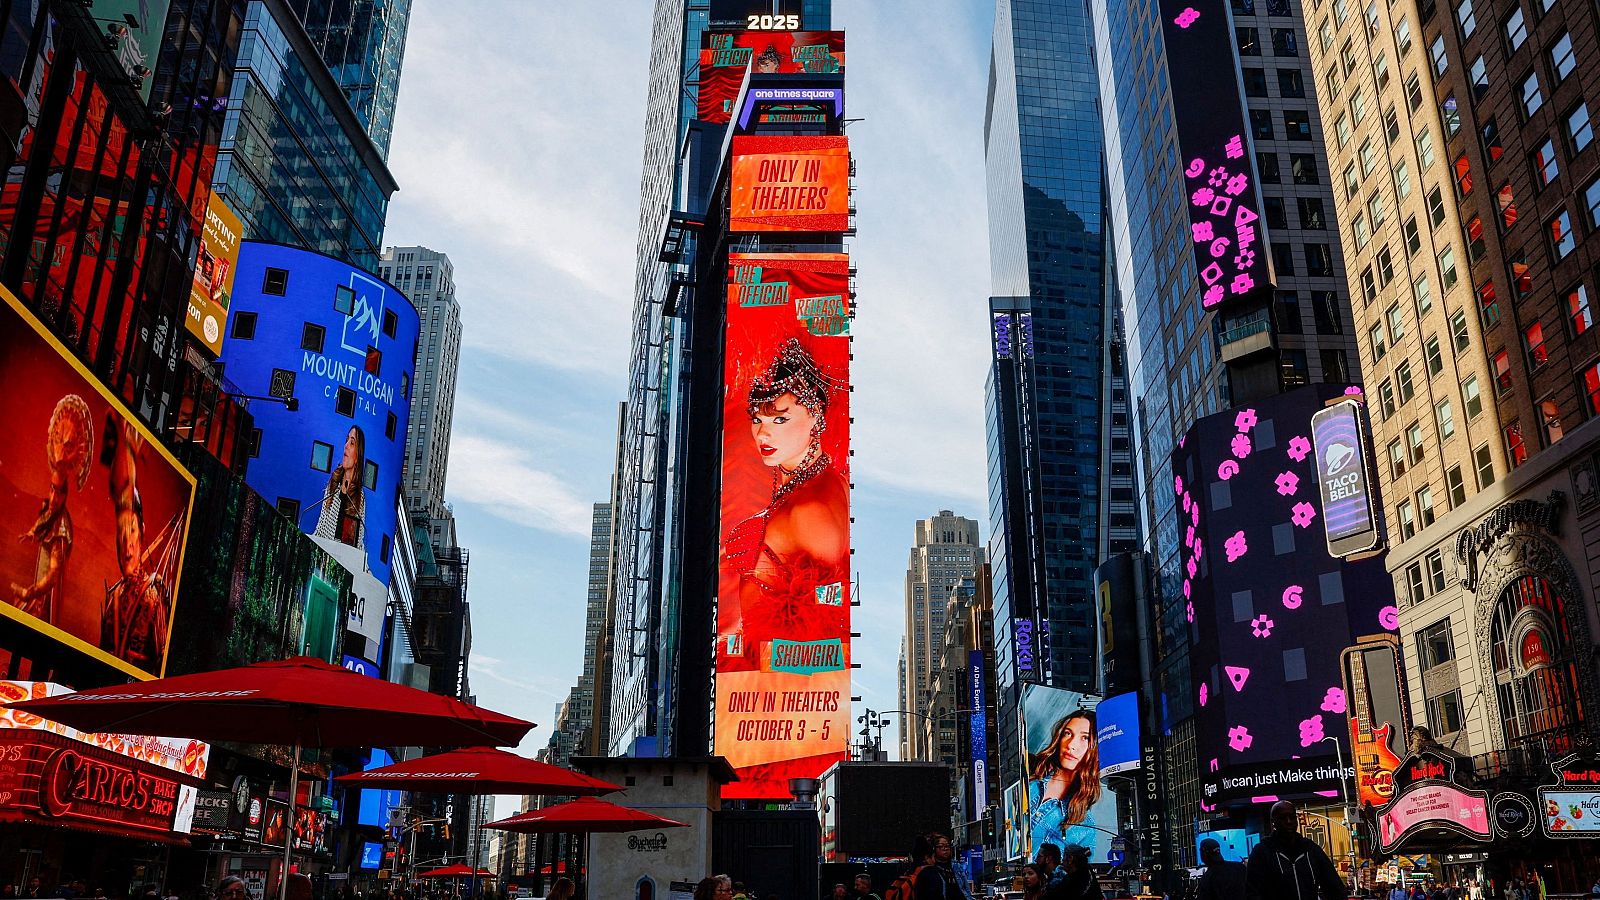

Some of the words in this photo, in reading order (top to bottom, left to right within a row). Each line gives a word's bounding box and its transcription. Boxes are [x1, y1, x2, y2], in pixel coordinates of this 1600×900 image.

[747, 15, 799, 30] 2025
[712, 48, 752, 65] OFFICIA
[778, 90, 801, 98] times
[802, 91, 835, 100] square
[758, 159, 800, 183] ONLY
[802, 159, 821, 183] IN
[751, 186, 828, 210] THEATERS
[734, 265, 756, 284] THE
[739, 284, 789, 305] OFFICIAL
[796, 299, 844, 317] RELEASE
[810, 317, 846, 334] PARTY
[302, 351, 356, 387] MOUNT
[357, 369, 394, 407] LOGAN
[1326, 471, 1359, 491] TACO
[1330, 483, 1361, 502] BELL
[732, 635, 741, 654] A
[774, 644, 841, 668] SHOWGIRL
[728, 691, 760, 713] ONLY
[762, 691, 777, 713] IN
[780, 690, 840, 713] THEATERS
[737, 720, 793, 741] OCTOBER
[796, 720, 806, 741] 3
[822, 720, 831, 741] 5
[1145, 746, 1157, 800] SQUARE
[1232, 776, 1253, 788] can
[1254, 772, 1278, 788] just
[1279, 768, 1314, 784] Make
[1315, 765, 1355, 783] things
[1411, 766, 1428, 780] Hard
[1428, 761, 1445, 778] Rock
[1564, 770, 1588, 781] Hard
[1589, 770, 1600, 783] Ro
[154, 780, 177, 799] BAKE
[1204, 784, 1217, 797] Figma
[150, 798, 174, 816] SHOP
[1580, 800, 1598, 808] Hard
[1150, 814, 1161, 856] TIMES
